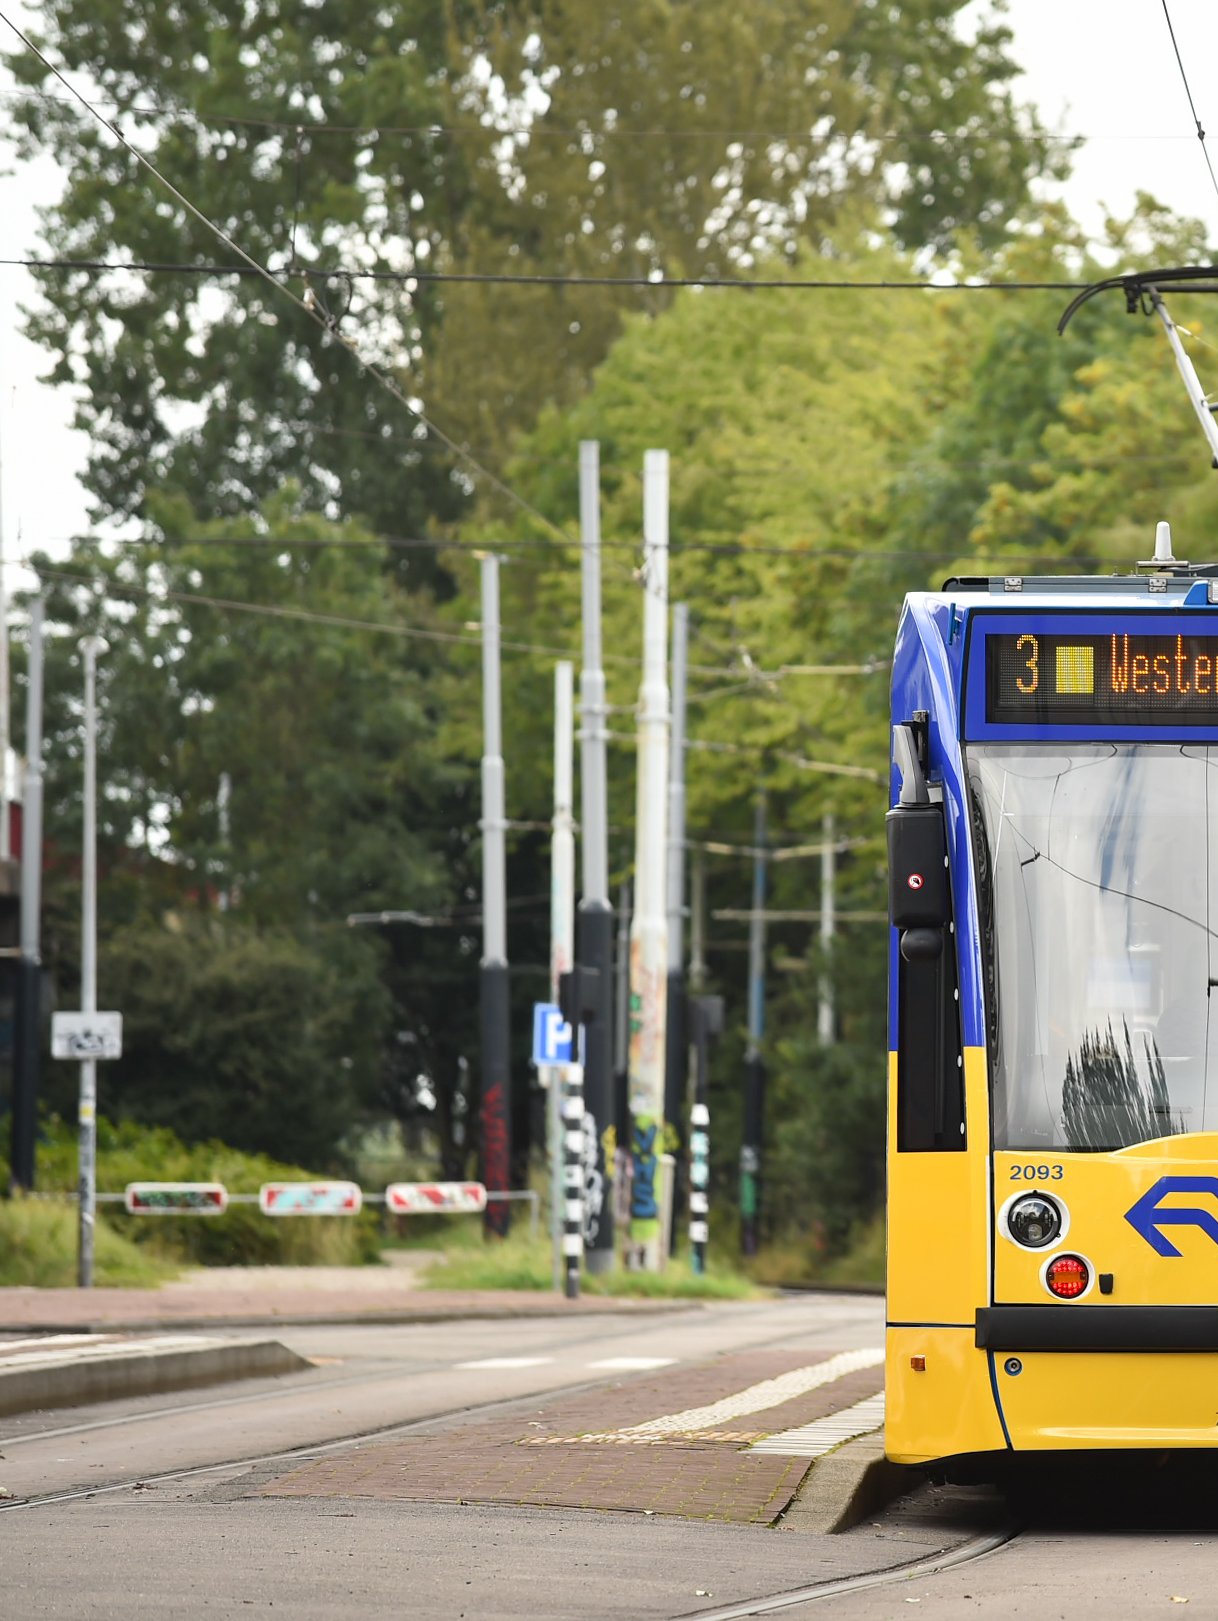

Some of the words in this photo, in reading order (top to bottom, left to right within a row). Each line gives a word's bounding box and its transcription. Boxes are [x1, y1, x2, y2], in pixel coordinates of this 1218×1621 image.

[1016, 634, 1039, 693] 3
[545, 1012, 573, 1059] P
[1009, 1164, 1064, 1180] 2093
